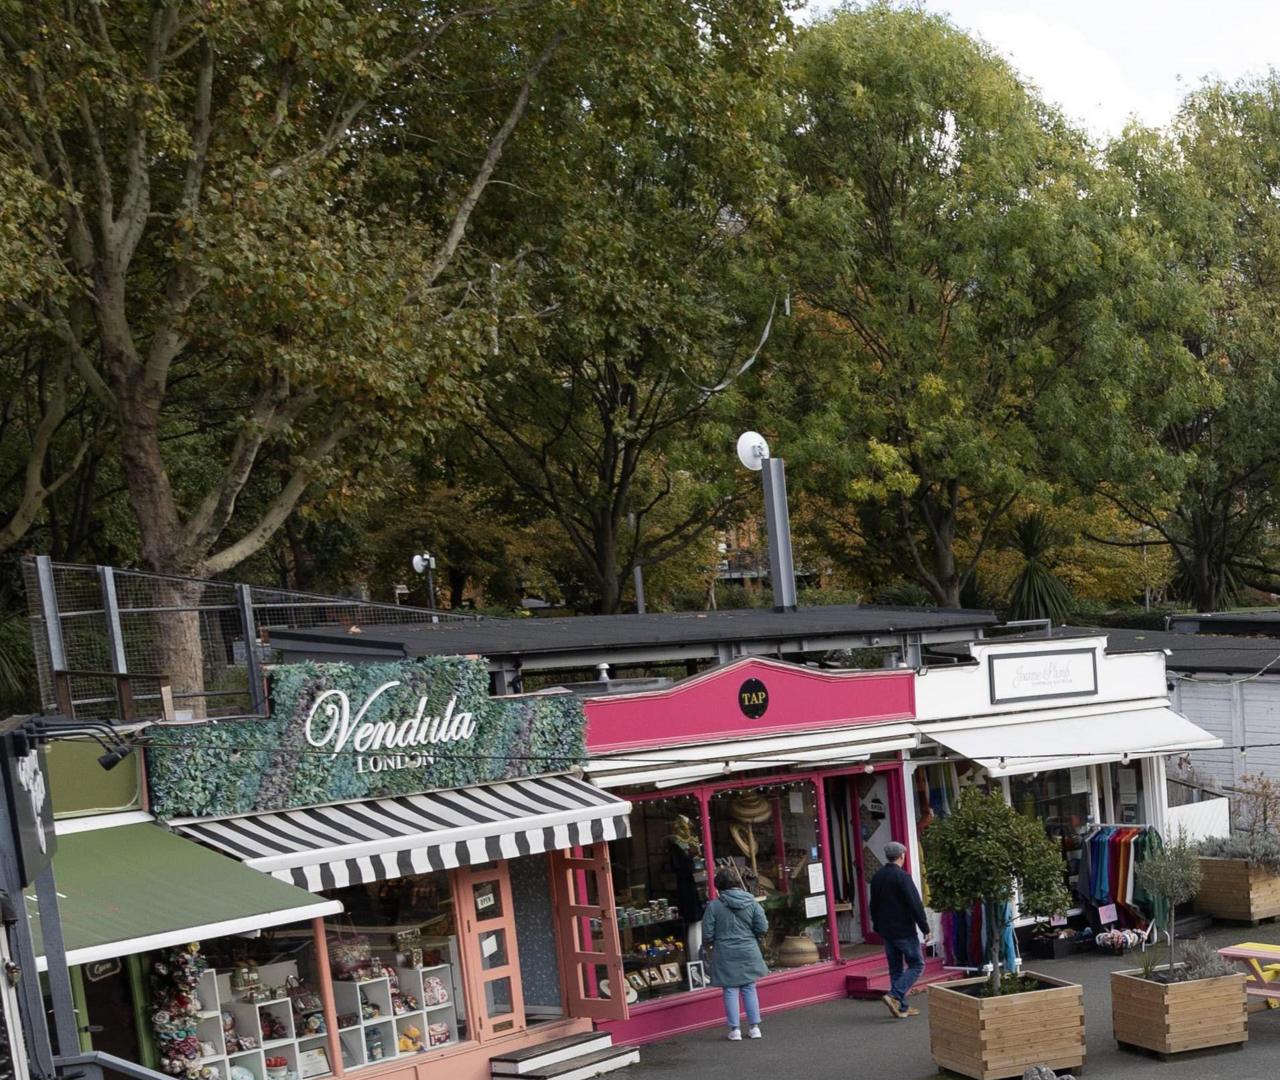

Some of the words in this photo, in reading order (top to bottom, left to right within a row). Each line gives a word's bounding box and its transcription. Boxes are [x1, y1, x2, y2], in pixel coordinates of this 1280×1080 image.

[741, 691, 766, 706] TAP
[305, 680, 477, 760] Vendula
[356, 751, 435, 774] LONDON
[480, 896, 492, 906] OPEN
